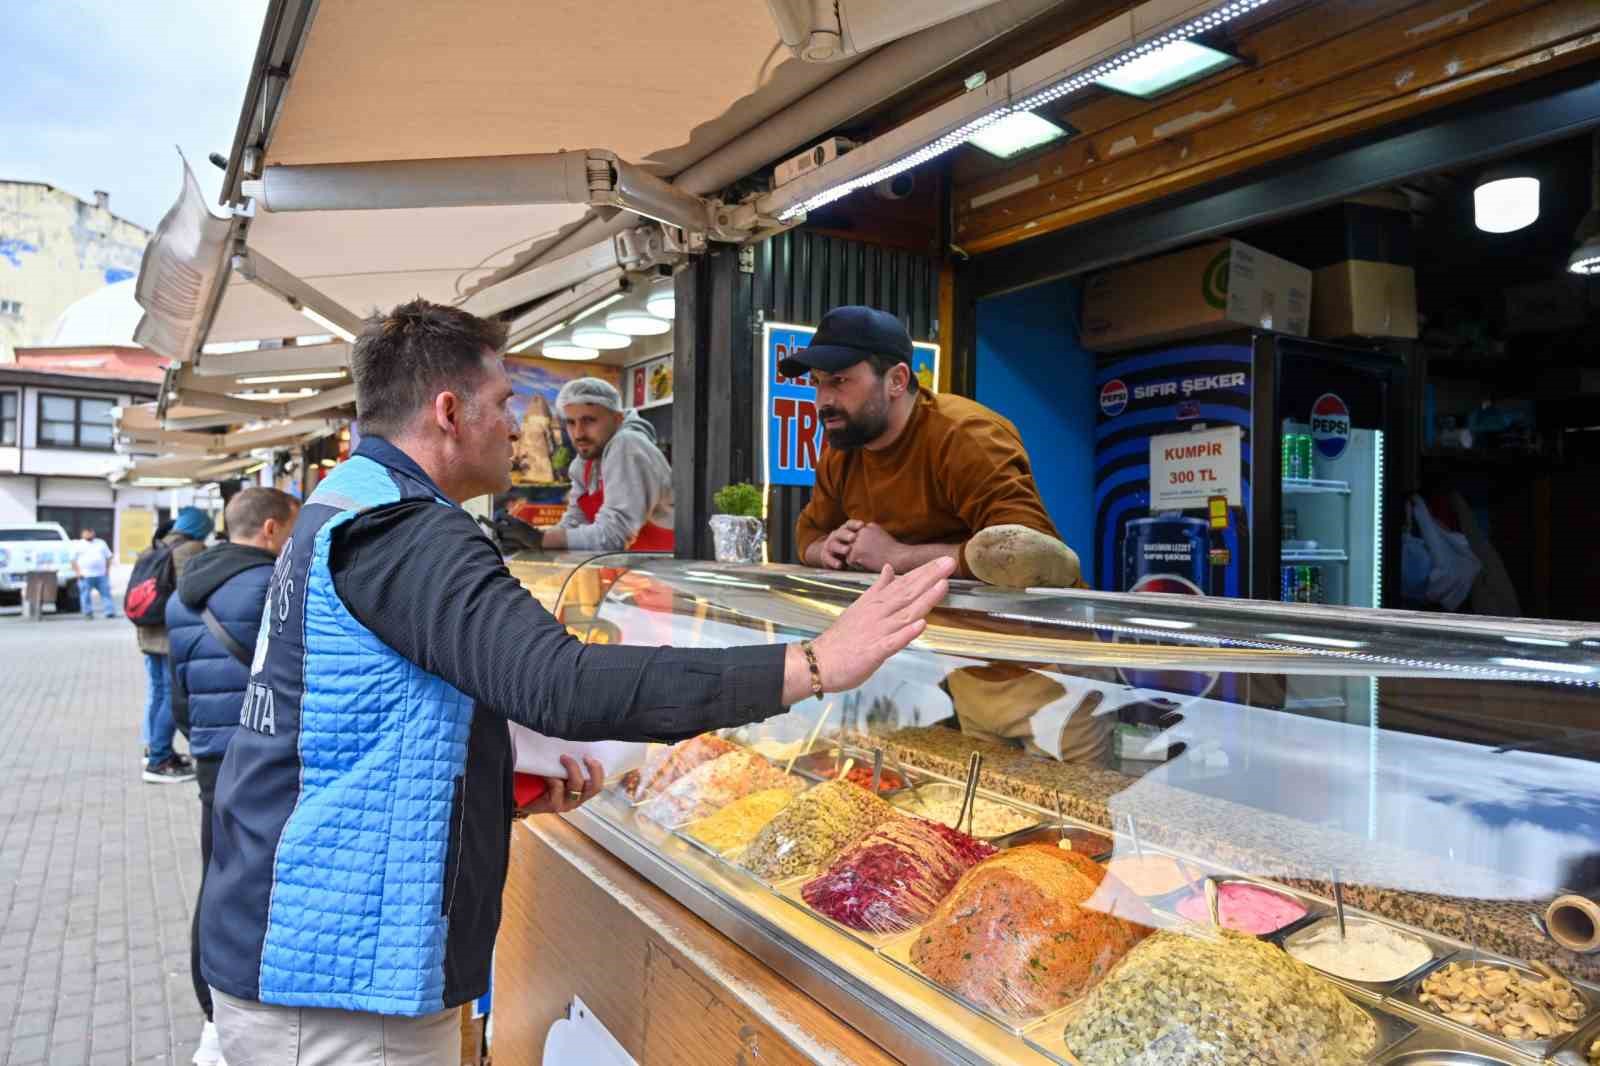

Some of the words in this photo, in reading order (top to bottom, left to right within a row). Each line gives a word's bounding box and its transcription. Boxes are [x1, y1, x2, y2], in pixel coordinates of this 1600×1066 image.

[1133, 382, 1177, 399] SIFIR
[1181, 372, 1246, 397] ŞEKER
[773, 397, 828, 471] TR
[1312, 418, 1348, 434] PEPSI
[1164, 441, 1222, 460] KUMPİR
[1169, 470, 1194, 484] 300
[1199, 468, 1217, 481] TL
